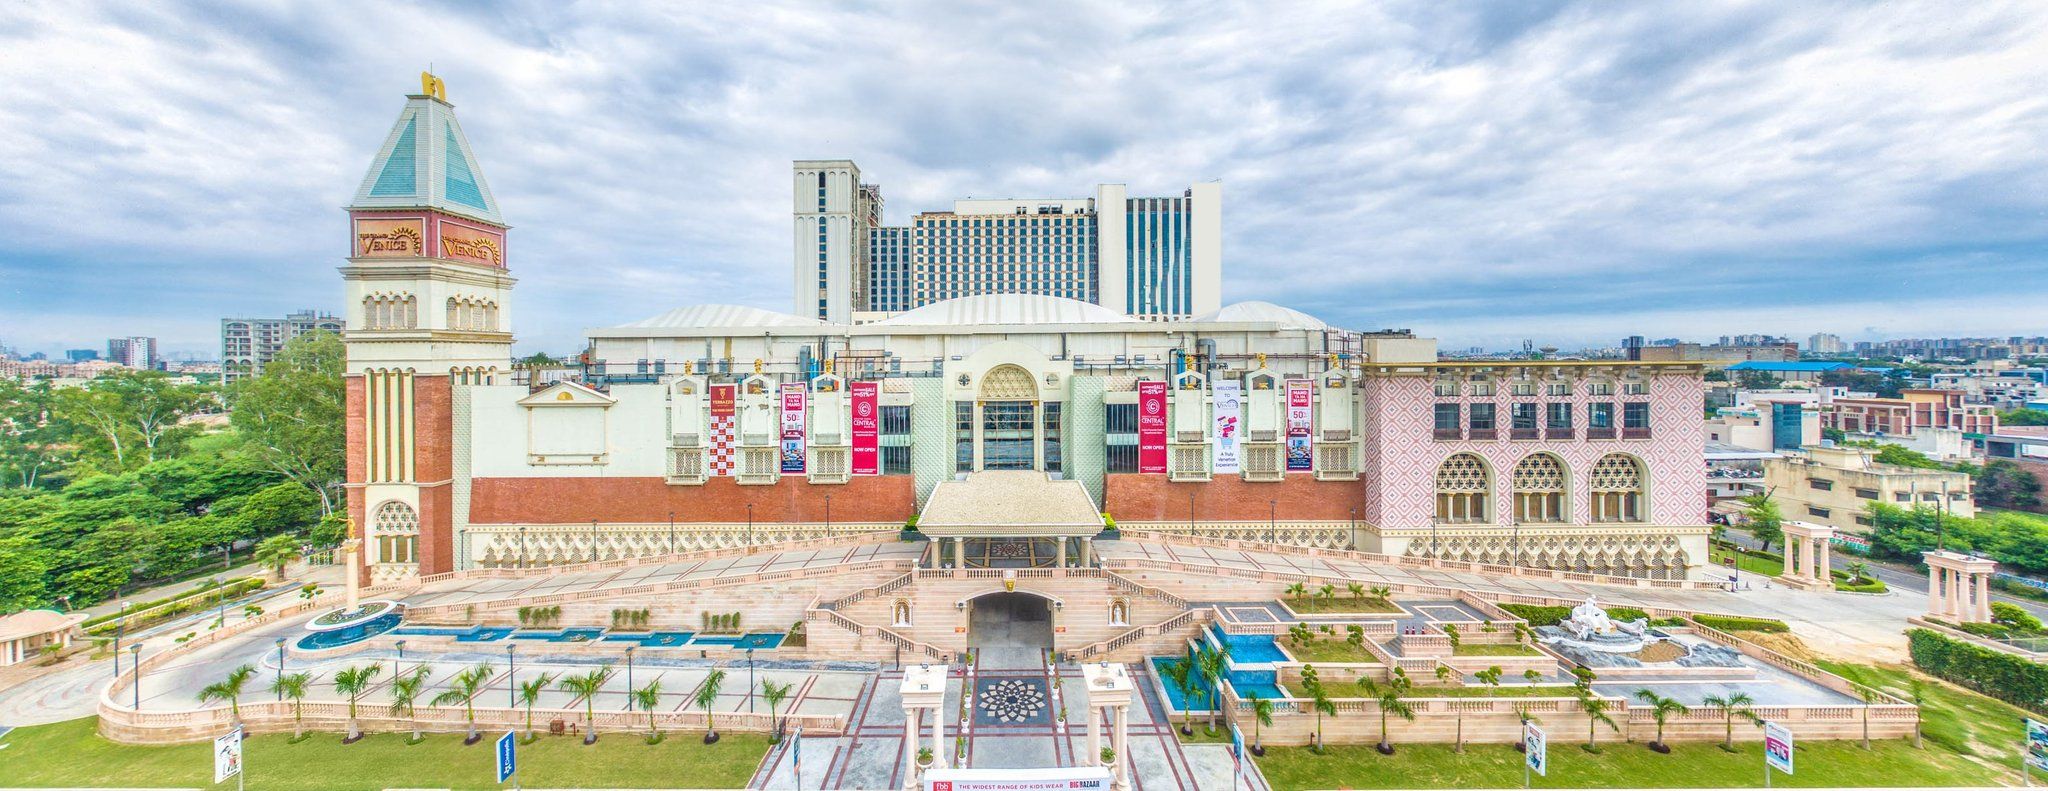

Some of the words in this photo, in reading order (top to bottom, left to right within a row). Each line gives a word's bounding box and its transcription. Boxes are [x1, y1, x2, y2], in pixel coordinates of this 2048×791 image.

[359, 238, 407, 254] VENICE
[440, 239, 488, 260] VENICE
[936, 782, 949, 790] fbb
